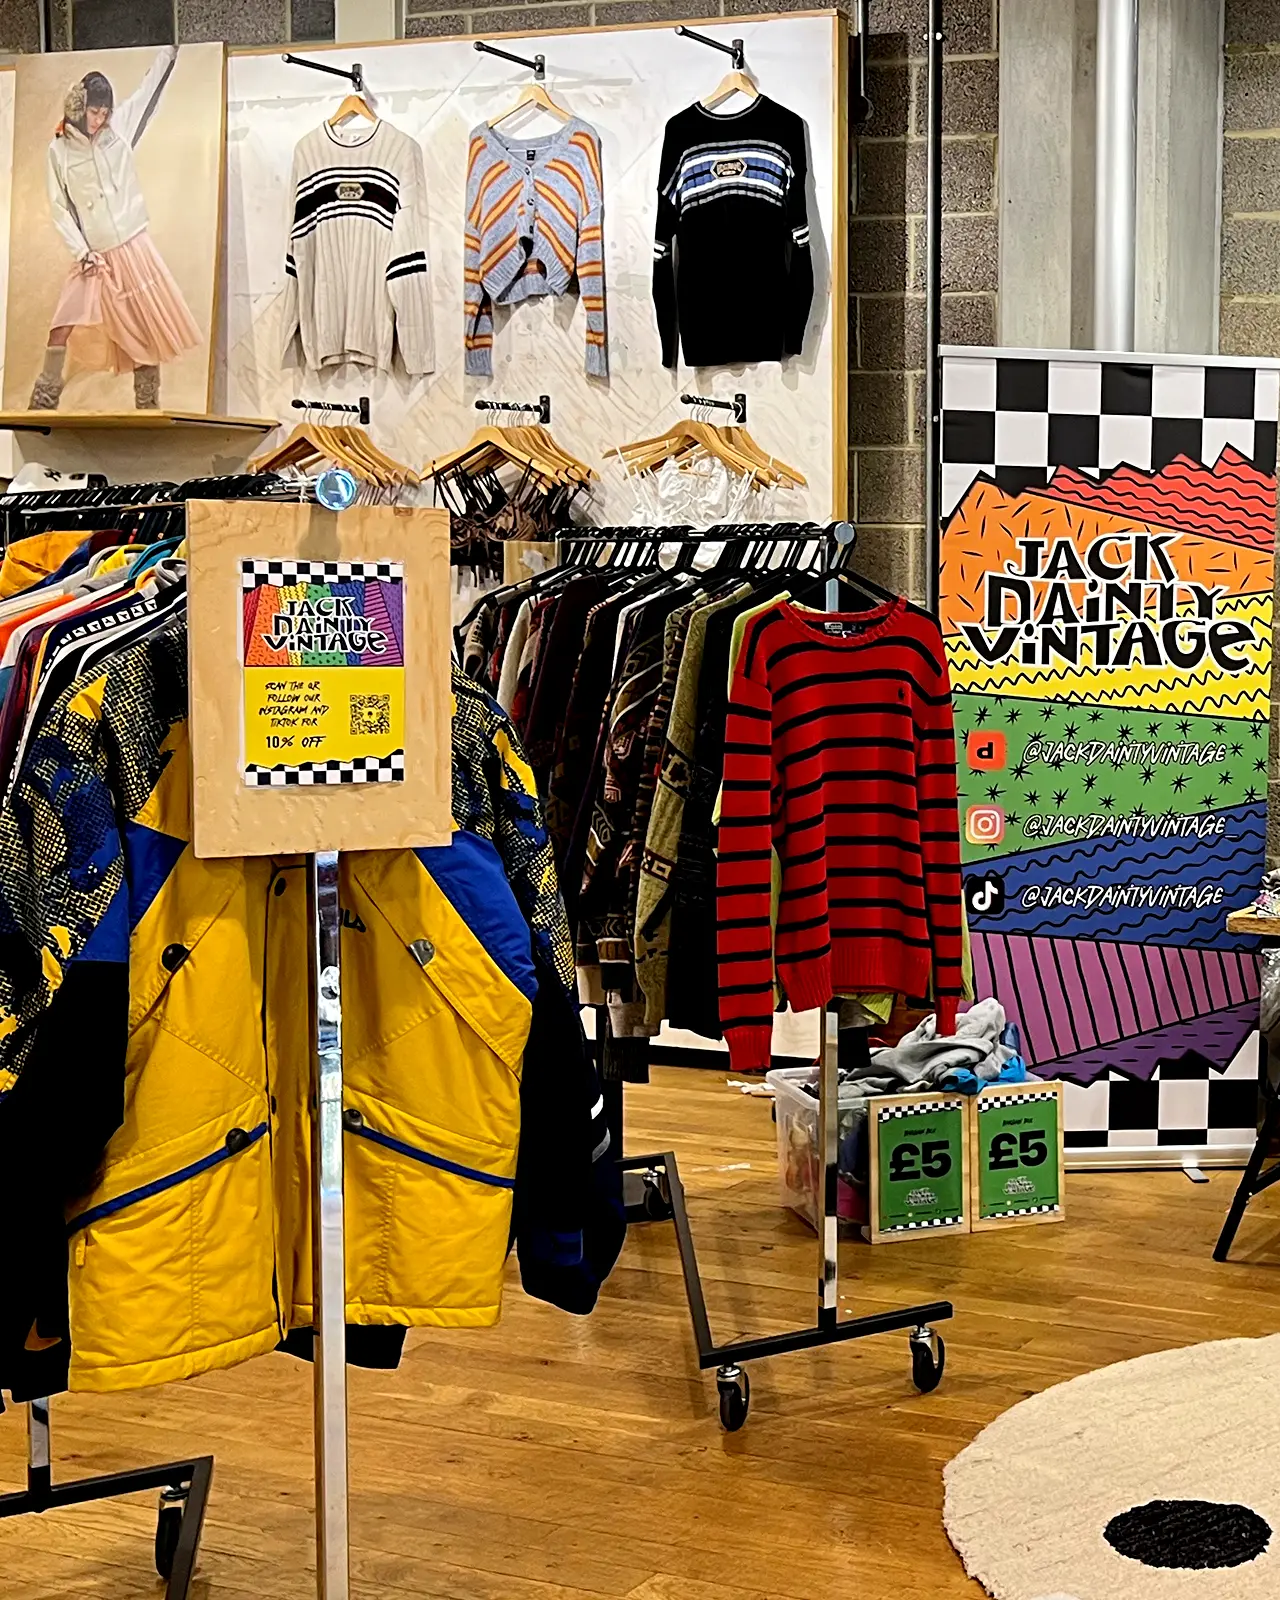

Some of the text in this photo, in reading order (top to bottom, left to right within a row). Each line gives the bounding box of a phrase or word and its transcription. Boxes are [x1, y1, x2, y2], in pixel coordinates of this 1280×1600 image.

[1006, 534, 1179, 582] JACK
[282, 597, 354, 617] JACK
[265, 681, 320, 691] SCAN THE QR
[267, 694, 321, 703] FOLLOW OUR
[258, 705, 329, 716] INSTAGRAM AND
[270, 717, 318, 727] TIKTOK FOR
[266, 735, 326, 749] 10% OFF
[989, 1129, 1048, 1171] £5
[889, 1139, 952, 1182] £5
